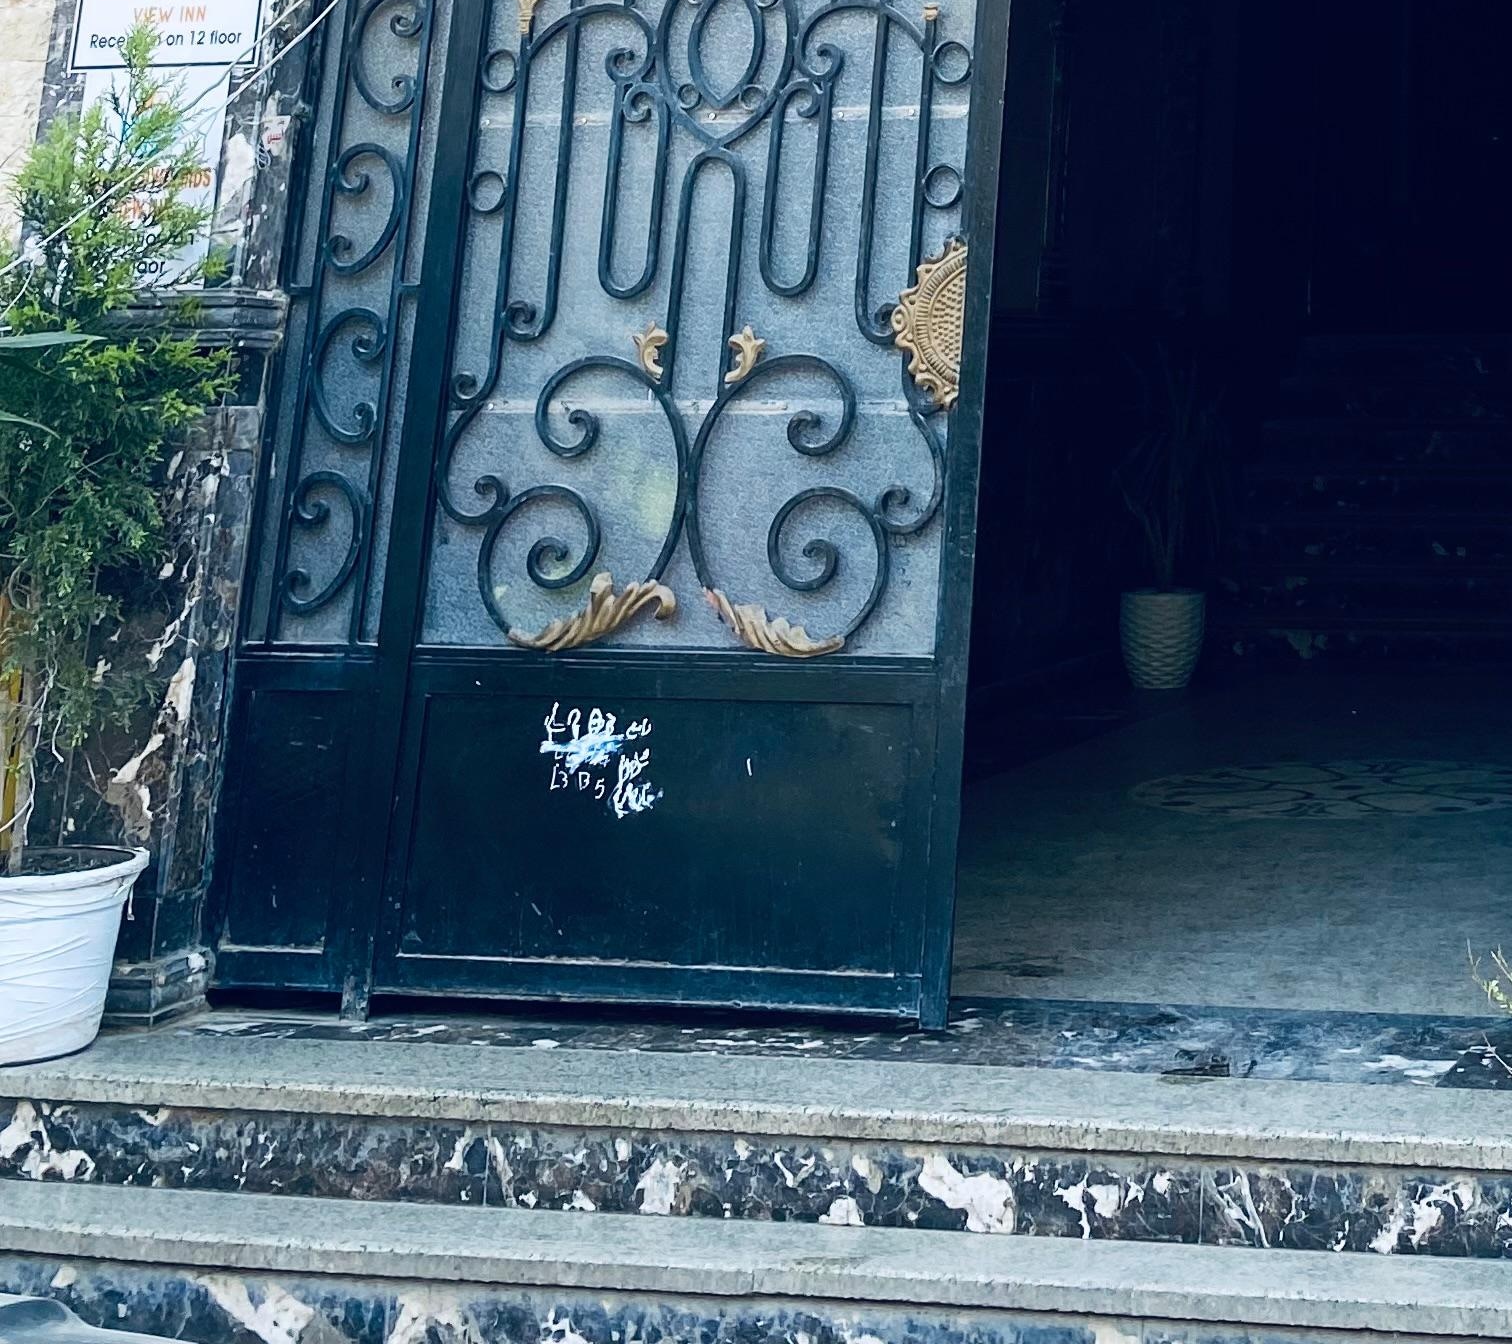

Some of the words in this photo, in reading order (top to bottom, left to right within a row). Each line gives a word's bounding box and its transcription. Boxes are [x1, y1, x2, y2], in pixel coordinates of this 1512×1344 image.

[134, 6, 174, 24] VIEW
[179, 5, 208, 23] INN
[166, 33, 184, 46] on
[190, 30, 205, 45] 12
[209, 29, 243, 46] floor
